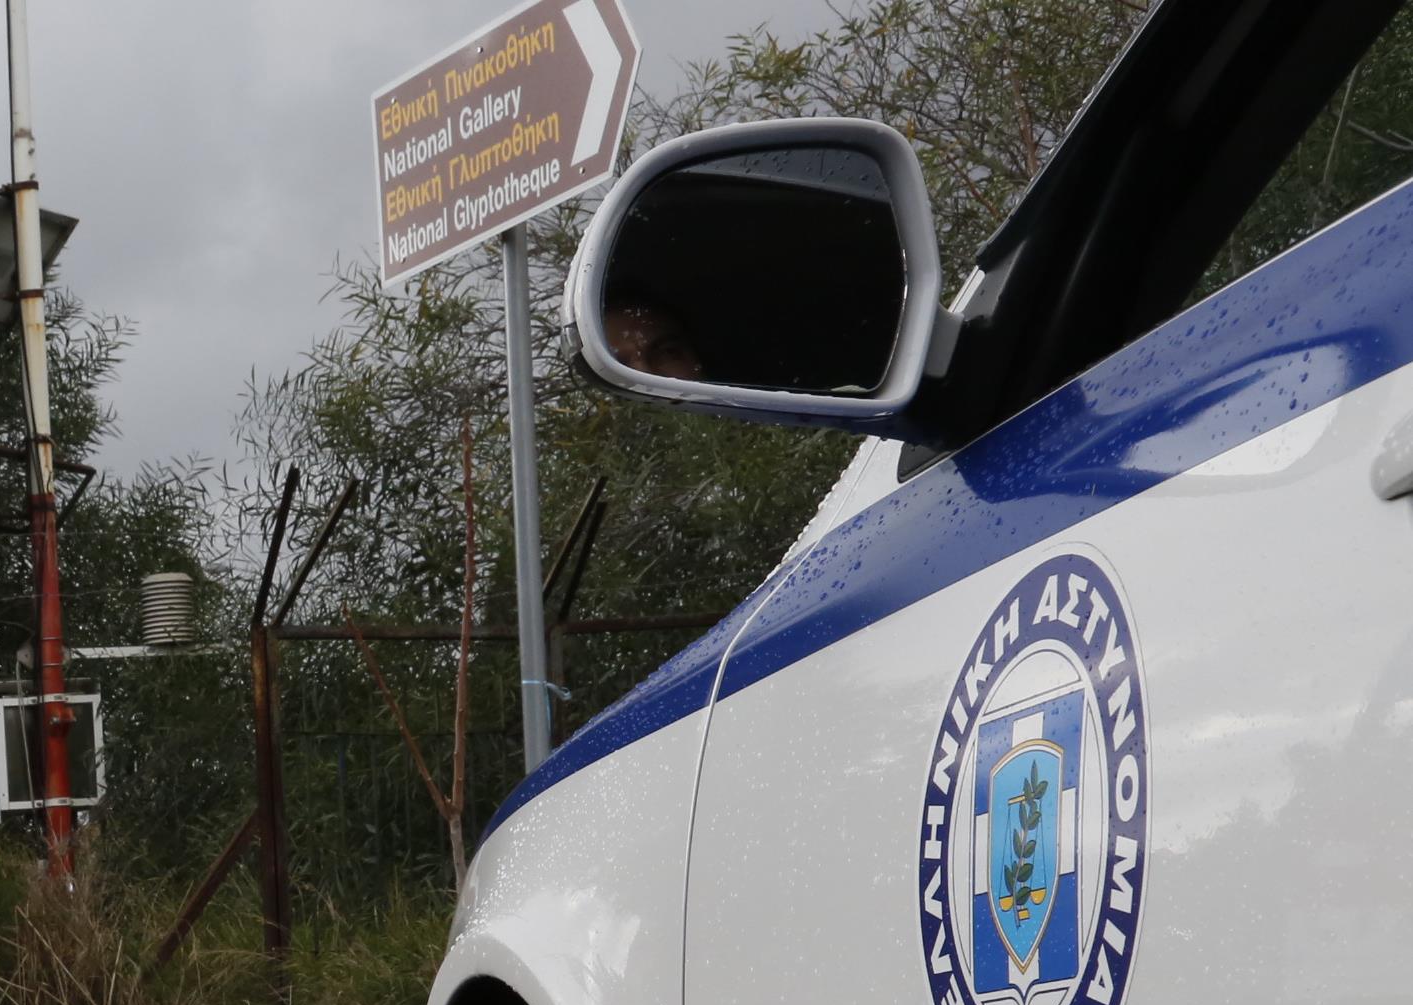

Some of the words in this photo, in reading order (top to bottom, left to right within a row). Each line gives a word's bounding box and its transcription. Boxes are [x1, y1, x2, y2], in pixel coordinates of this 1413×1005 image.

[380, 79, 439, 140] Εθνική
[445, 21, 555, 104] Πινακοθήκη
[383, 118, 452, 182] National
[459, 86, 521, 140] Gallery
[387, 165, 443, 222] Εθνική
[449, 112, 560, 190] Γλυπτοθήκη
[388, 207, 448, 265] National
[453, 158, 560, 232] Glyptotheque
